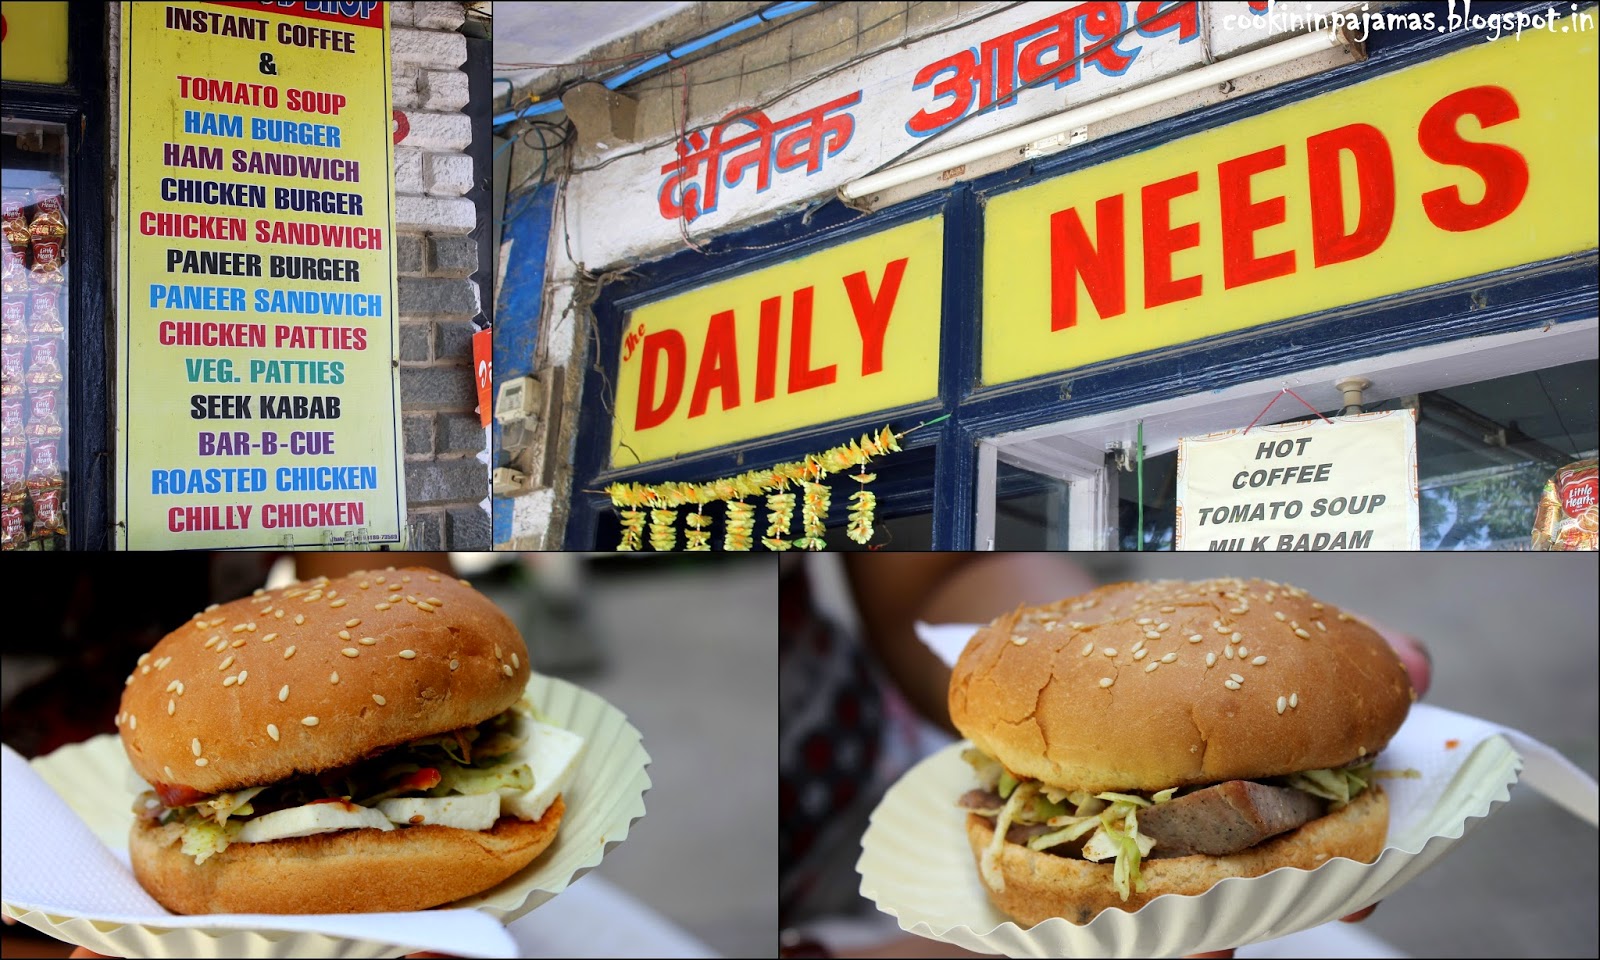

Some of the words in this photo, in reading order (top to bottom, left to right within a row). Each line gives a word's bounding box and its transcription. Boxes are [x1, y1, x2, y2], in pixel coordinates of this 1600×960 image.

[166, 7, 269, 41] INSTANT
[278, 22, 355, 53] COFFEE
[259, 53, 277, 75] &
[177, 75, 278, 108] TOMATO
[287, 88, 346, 115] SOUP
[184, 110, 243, 138] HAM
[251, 117, 341, 147] BURGER
[164, 143, 223, 170] HAM
[232, 149, 360, 182] SANDWICH
[657, 106, 863, 224] दैनिक
[161, 177, 266, 208] CHICKEN
[274, 187, 363, 216] BURGER
[140, 211, 247, 241] CHICKEN
[255, 219, 382, 250] SANDWICH
[167, 249, 261, 277] PANEER
[270, 254, 360, 282] BURGER
[634, 257, 909, 432] DAILY
[1051, 85, 1529, 332] NEEDS
[150, 284, 246, 312] PANEER
[254, 288, 382, 317] SANDWICH
[159, 321, 266, 348] CHICKEN
[275, 325, 367, 351] PATTIES
[623, 323, 645, 362] The
[186, 358, 241, 383] VEG.
[250, 359, 345, 385] PATTIES
[190, 394, 252, 420] SEEK
[260, 395, 341, 420] KABAB
[199, 431, 335, 456] BAR-B-CUE
[1255, 437, 1312, 460] HOT
[151, 468, 267, 495] ROASTED
[276, 466, 377, 492] CHICKEN
[1232, 463, 1333, 490] COFFEE
[1569, 484, 1592, 498] Little
[168, 505, 252, 533] CHILLY
[261, 502, 365, 529] CHICKEN
[1199, 500, 1303, 526] TOMATO
[1311, 494, 1386, 517] SOUP
[1566, 496, 1595, 508] Hearts
[1276, 530, 1374, 551] BADAM
